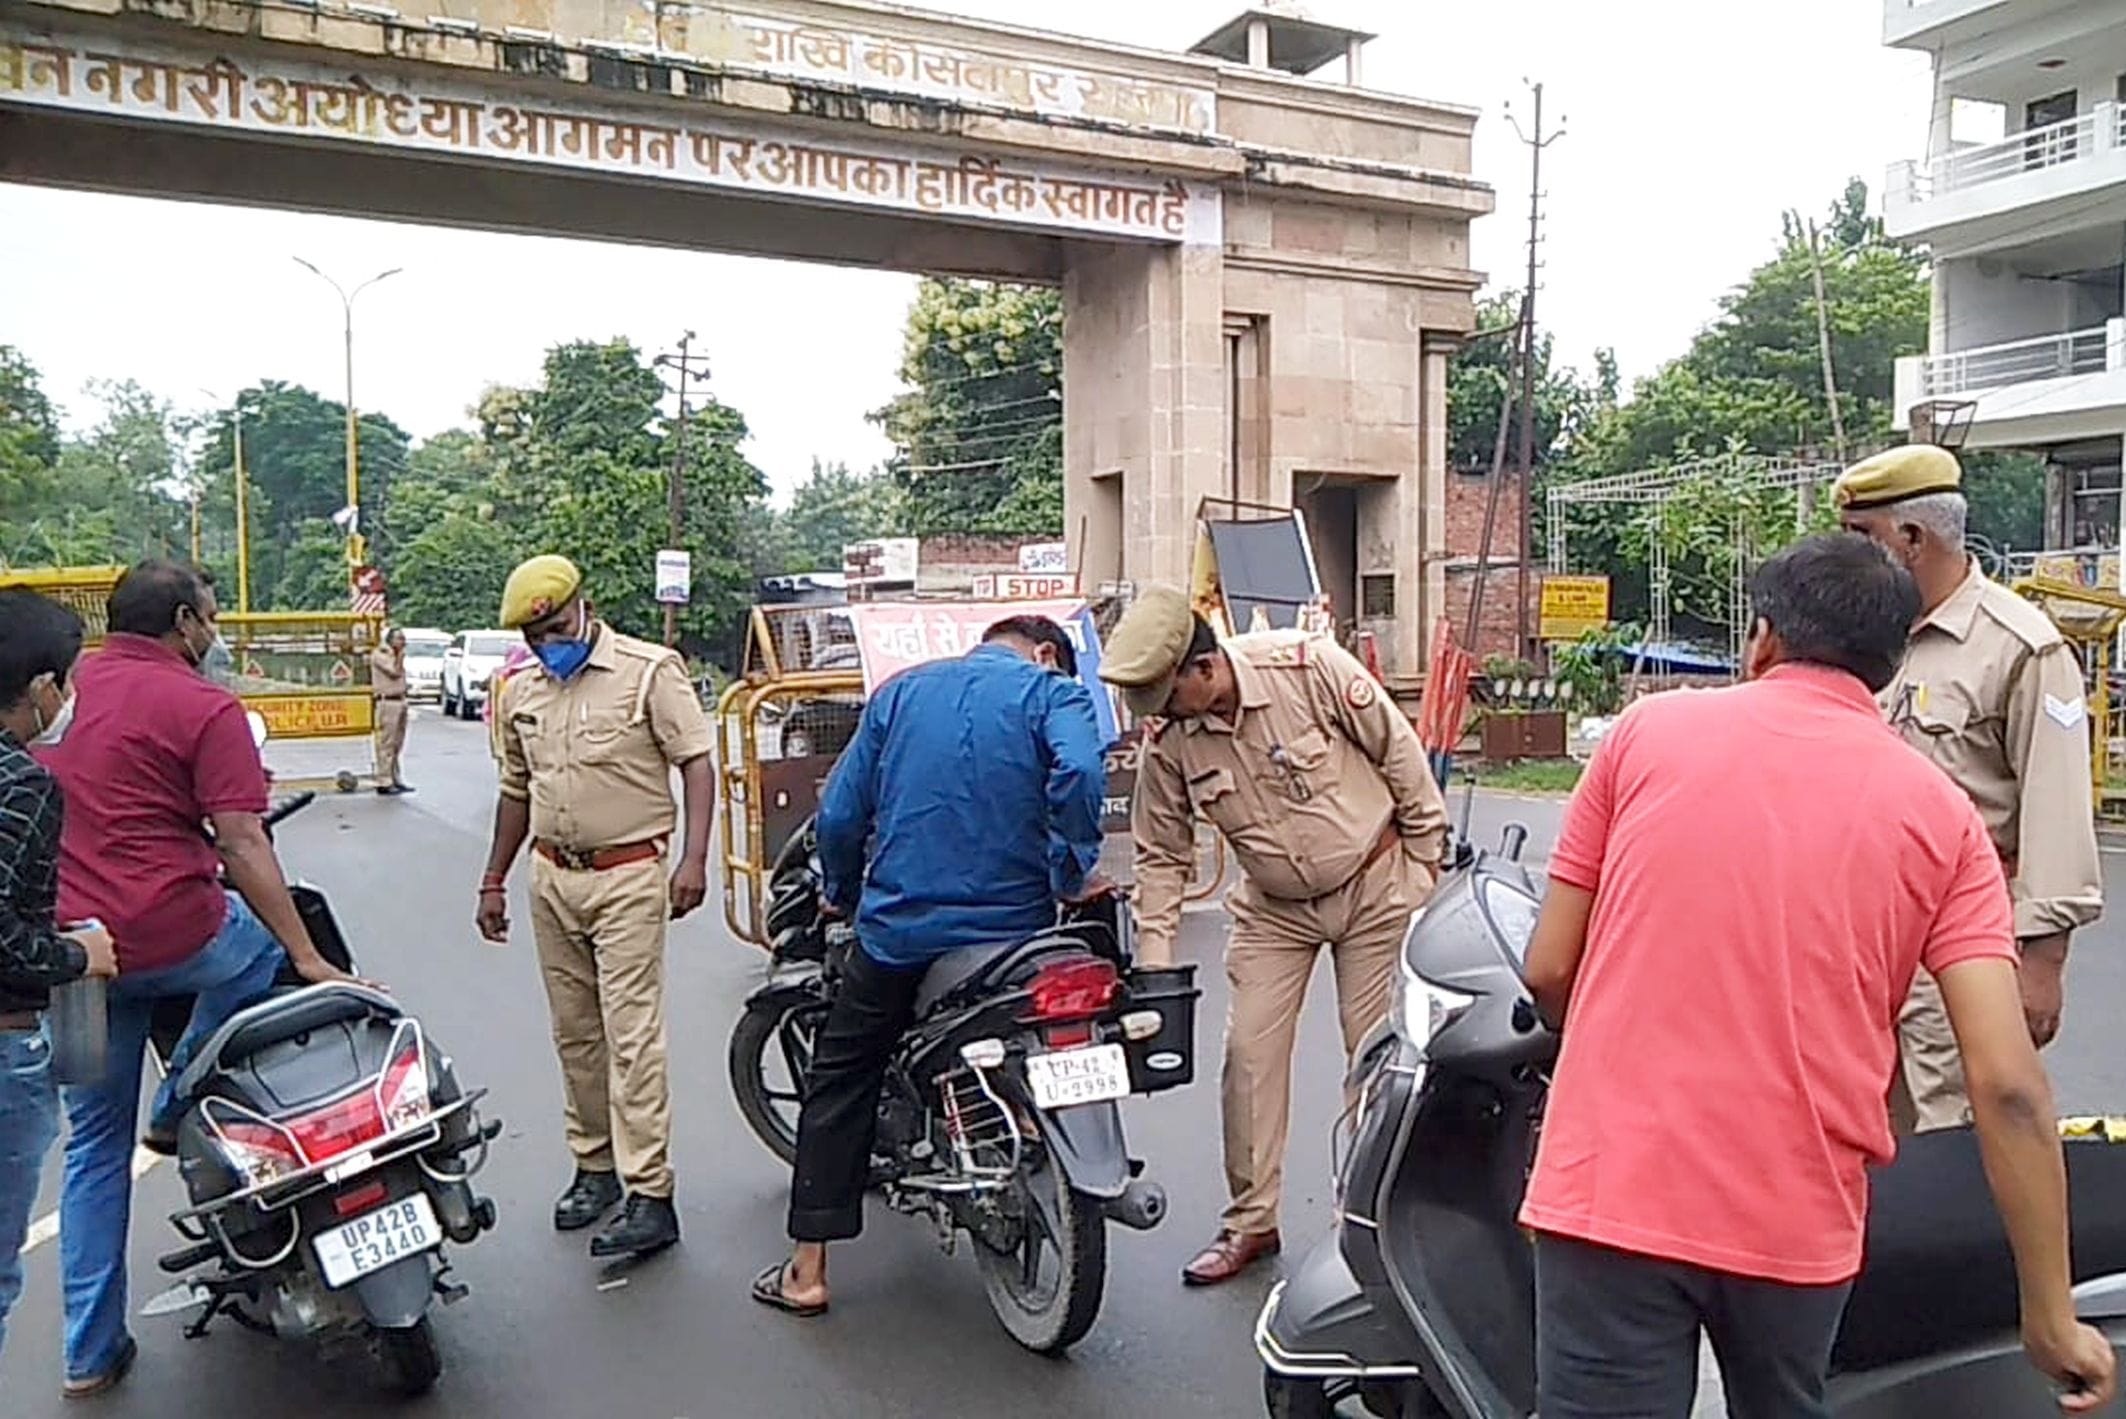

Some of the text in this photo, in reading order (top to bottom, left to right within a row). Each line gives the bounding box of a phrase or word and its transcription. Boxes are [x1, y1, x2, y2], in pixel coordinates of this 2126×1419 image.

[84, 52, 247, 119] नगरी
[250, 74, 485, 147] अयोध्या
[487, 106, 682, 170] आगमन
[686, 132, 757, 181] पर
[756, 141, 912, 200] आपका
[915, 156, 1036, 214] हार्दिक
[1039, 177, 1161, 227] स्वागत
[1008, 578, 1065, 597] STOP
[341, 1202, 418, 1248] UP42B
[350, 1224, 427, 1271] E3440
